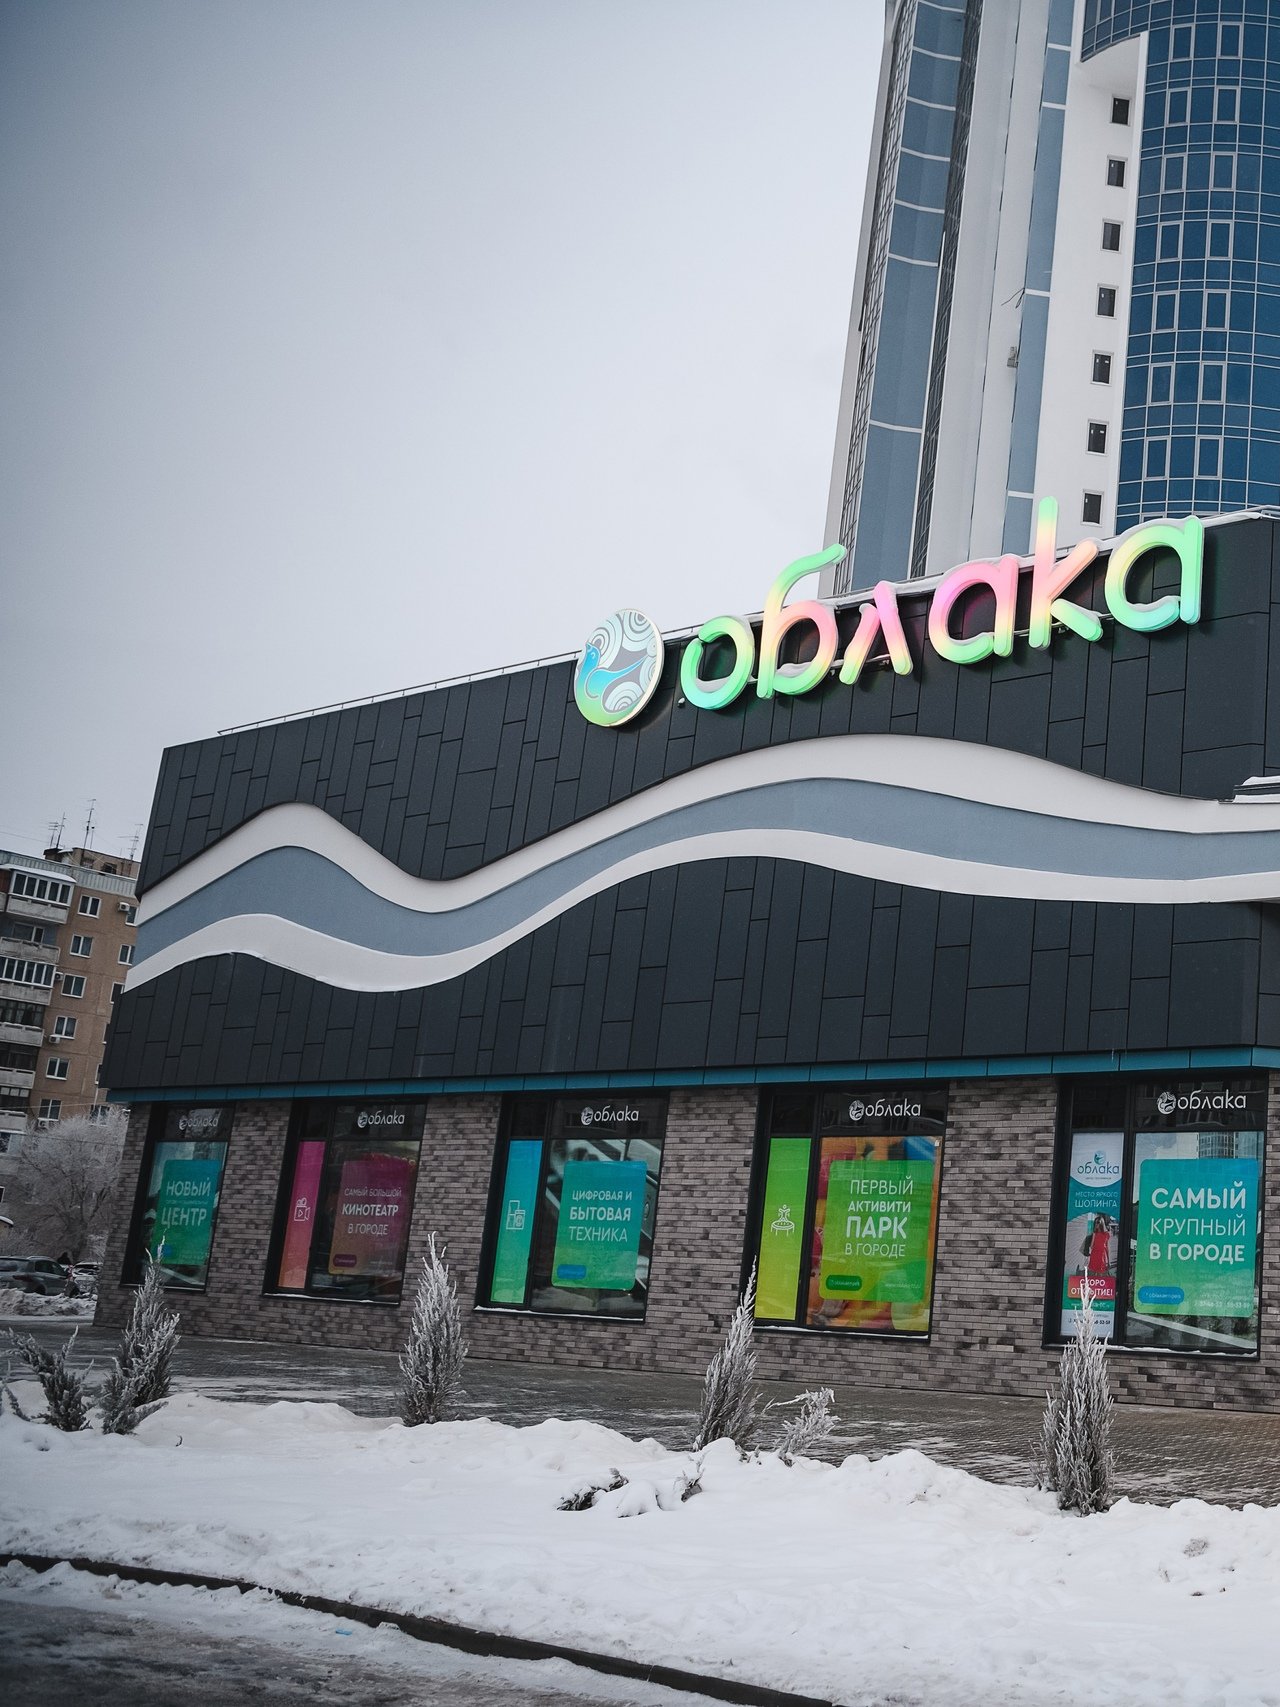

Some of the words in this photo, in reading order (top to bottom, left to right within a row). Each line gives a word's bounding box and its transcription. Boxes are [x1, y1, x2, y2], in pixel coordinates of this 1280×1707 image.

[680, 496, 1204, 710] облака
[865, 1098, 921, 1117] облака
[1177, 1089, 1247, 1110] облака
[367, 1109, 405, 1125] облака
[594, 1105, 639, 1122] облака
[1077, 1162, 1120, 1174] облака
[166, 1177, 212, 1197] НОВЫЙ
[344, 1186, 368, 1196] САМЫЙ
[369, 1187, 402, 1197] БОЛЬШОЙ
[850, 1176, 914, 1195] ПЕРВЫЙ
[572, 1190, 623, 1201] ЦИФРОВАЯ
[625, 1191, 632, 1200] И
[1151, 1181, 1246, 1209] САМЫЙ
[342, 1203, 399, 1217] КИНОТЕАТР
[848, 1200, 911, 1213] АКТИВИТИ
[1075, 1200, 1117, 1208] ШОПИНГА
[161, 1206, 208, 1228] ЦЕНТР
[569, 1206, 632, 1221] БЫТОВАЯ
[347, 1223, 353, 1234] В
[355, 1224, 389, 1237] ГОРОДЕ
[846, 1216, 908, 1239] ПАРК
[1150, 1214, 1247, 1237] КРУПНЫЙ
[568, 1226, 628, 1242] ТЕХНИКА
[845, 1243, 853, 1256] В
[855, 1243, 906, 1259] ГОРОДЕ
[1149, 1244, 1161, 1260] В
[1167, 1244, 1245, 1265] ГОРОДЕ
[1071, 1287, 1113, 1296] ОТЫТИЕ!
